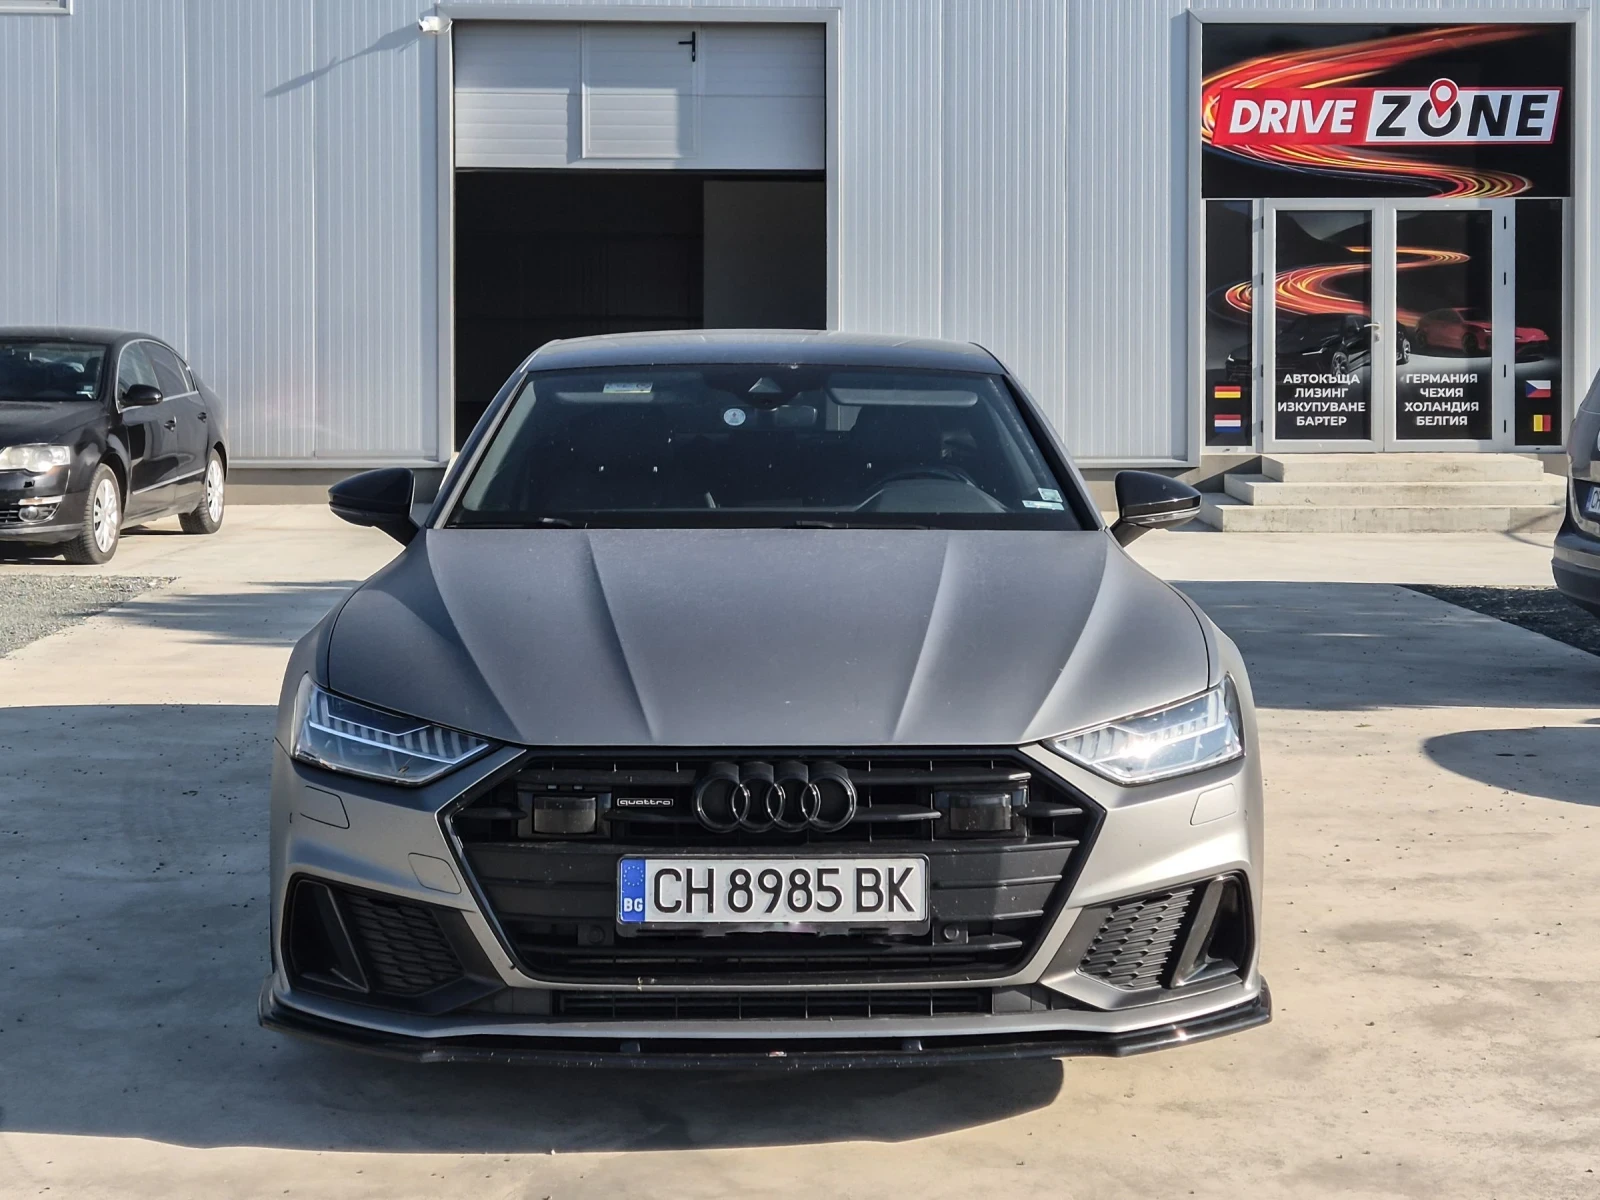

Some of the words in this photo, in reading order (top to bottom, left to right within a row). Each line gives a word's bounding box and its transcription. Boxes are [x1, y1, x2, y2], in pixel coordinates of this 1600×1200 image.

[1229, 99, 1357, 134] DRIVE
[1375, 93, 1550, 138] ZONE
[1282, 373, 1361, 386] АВТОКЪЩА
[1405, 373, 1478, 384] ГЕРМАНИЯ
[1294, 387, 1349, 398] ЛИЗИНГ
[1419, 387, 1464, 398] ЧЕХИЯ
[1277, 401, 1366, 412] ИЗКУПУВАНЕ
[1404, 401, 1480, 413] ХОЛАНДИЯ
[1296, 415, 1348, 426] БАРТЕР
[1416, 415, 1468, 426] БЕЛГИЯ
[653, 868, 716, 914] CH
[727, 868, 843, 914] 8985
[855, 867, 916, 913] BK
[623, 898, 644, 912] BG
